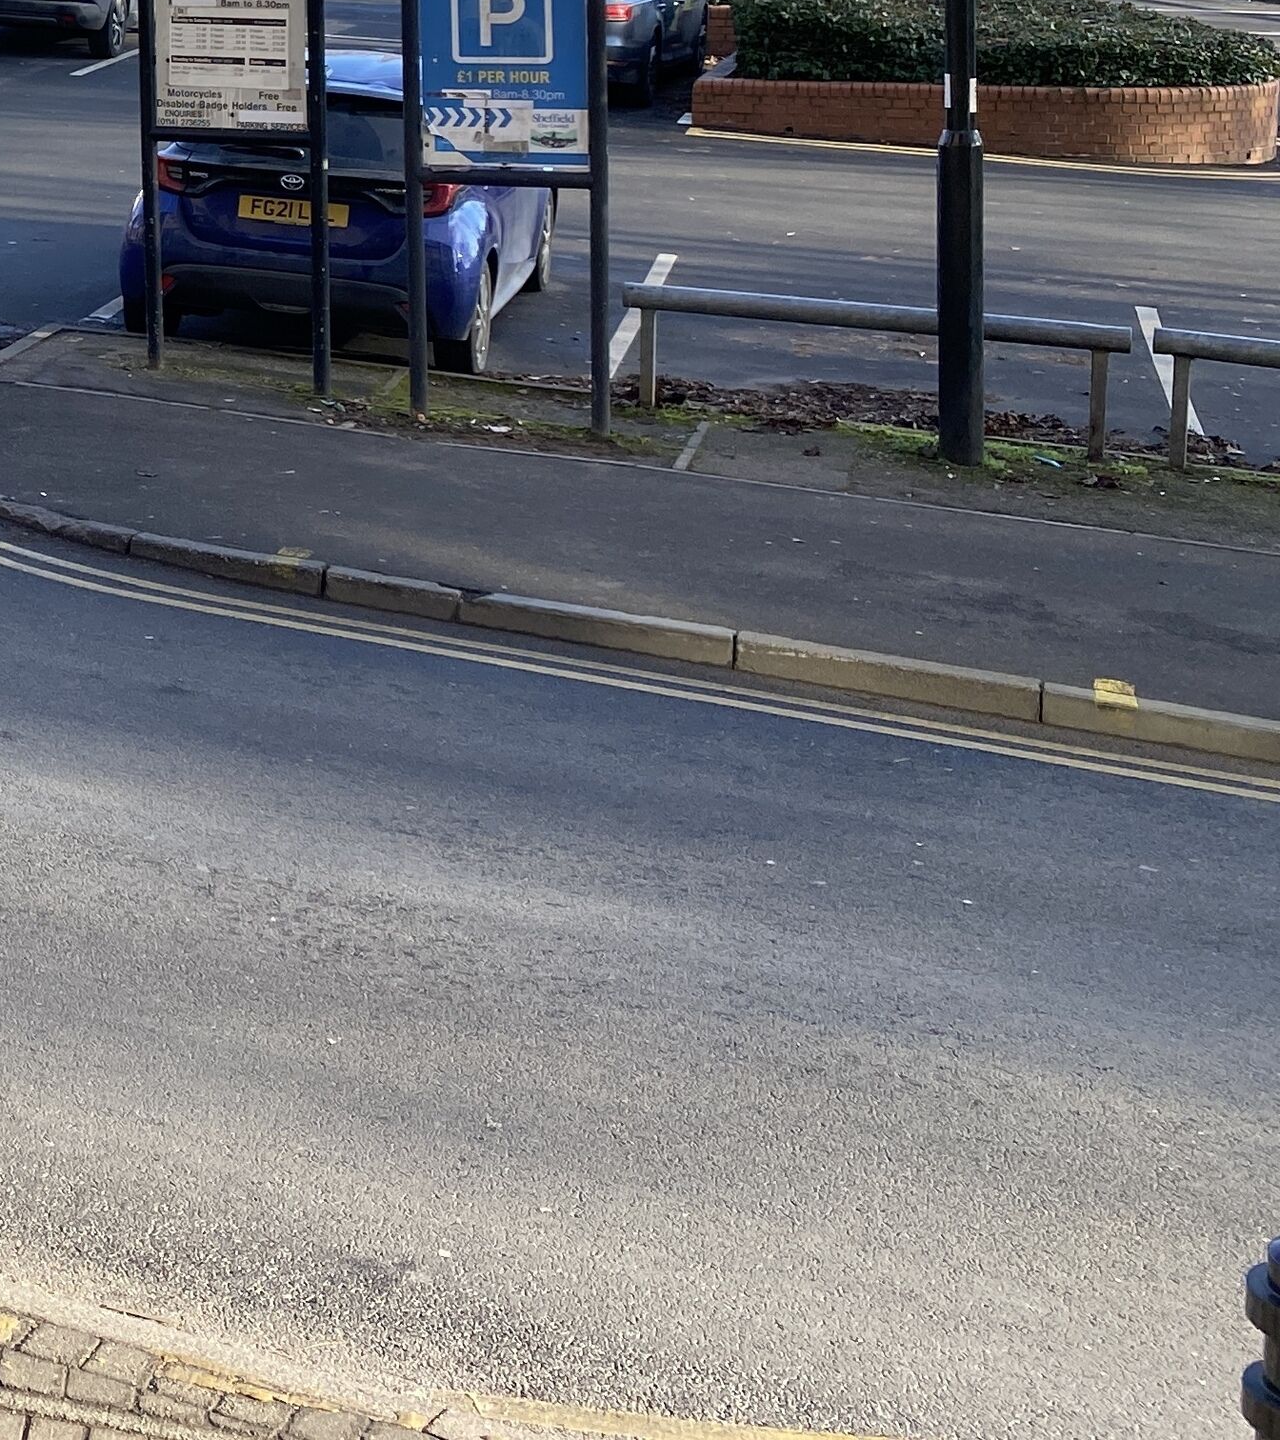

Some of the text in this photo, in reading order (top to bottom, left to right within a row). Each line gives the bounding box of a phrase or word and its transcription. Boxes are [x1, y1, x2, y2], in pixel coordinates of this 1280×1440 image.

[220, 0, 290, 9] 8am to 8.30pm
[457, 71, 551, 84] £1 PER HOUR
[167, 88, 280, 101] Motorcycles Free
[156, 99, 297, 112] Disabled Badge Holders Free
[532, 112, 576, 123] Sheffield
[236, 121, 307, 131] PARKING SERVICES
[250, 198, 294, 218] FG21
